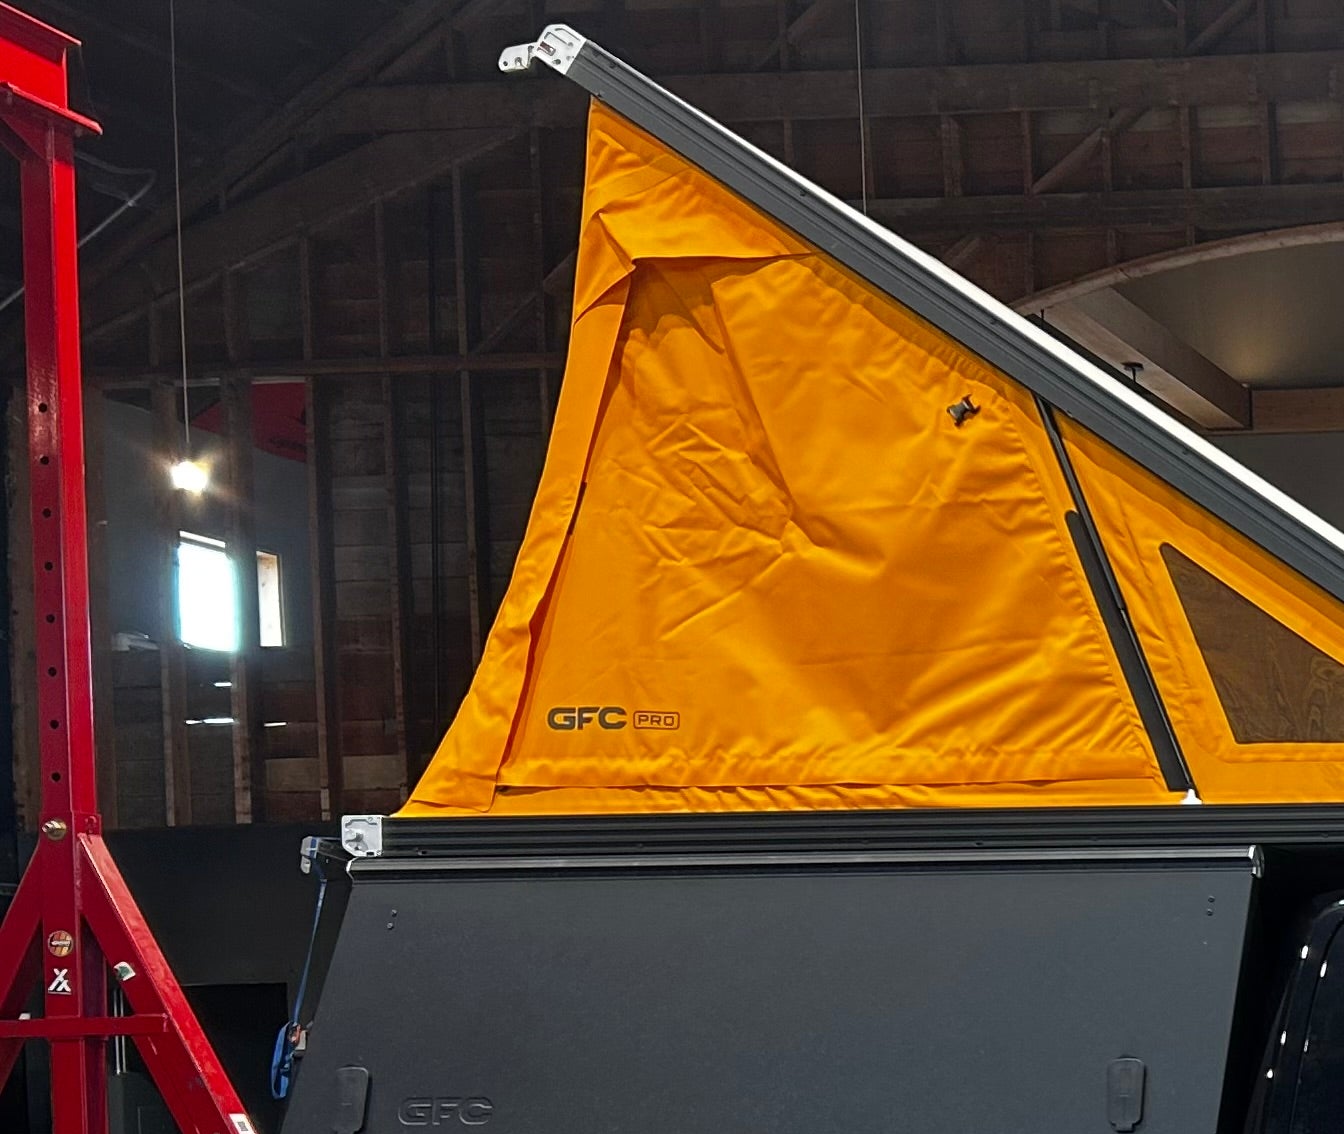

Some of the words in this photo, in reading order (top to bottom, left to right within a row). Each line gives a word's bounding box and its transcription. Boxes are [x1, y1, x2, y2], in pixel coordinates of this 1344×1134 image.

[547, 706, 628, 731] GFC
[637, 714, 676, 727] PRO
[397, 1096, 494, 1126] GFC
